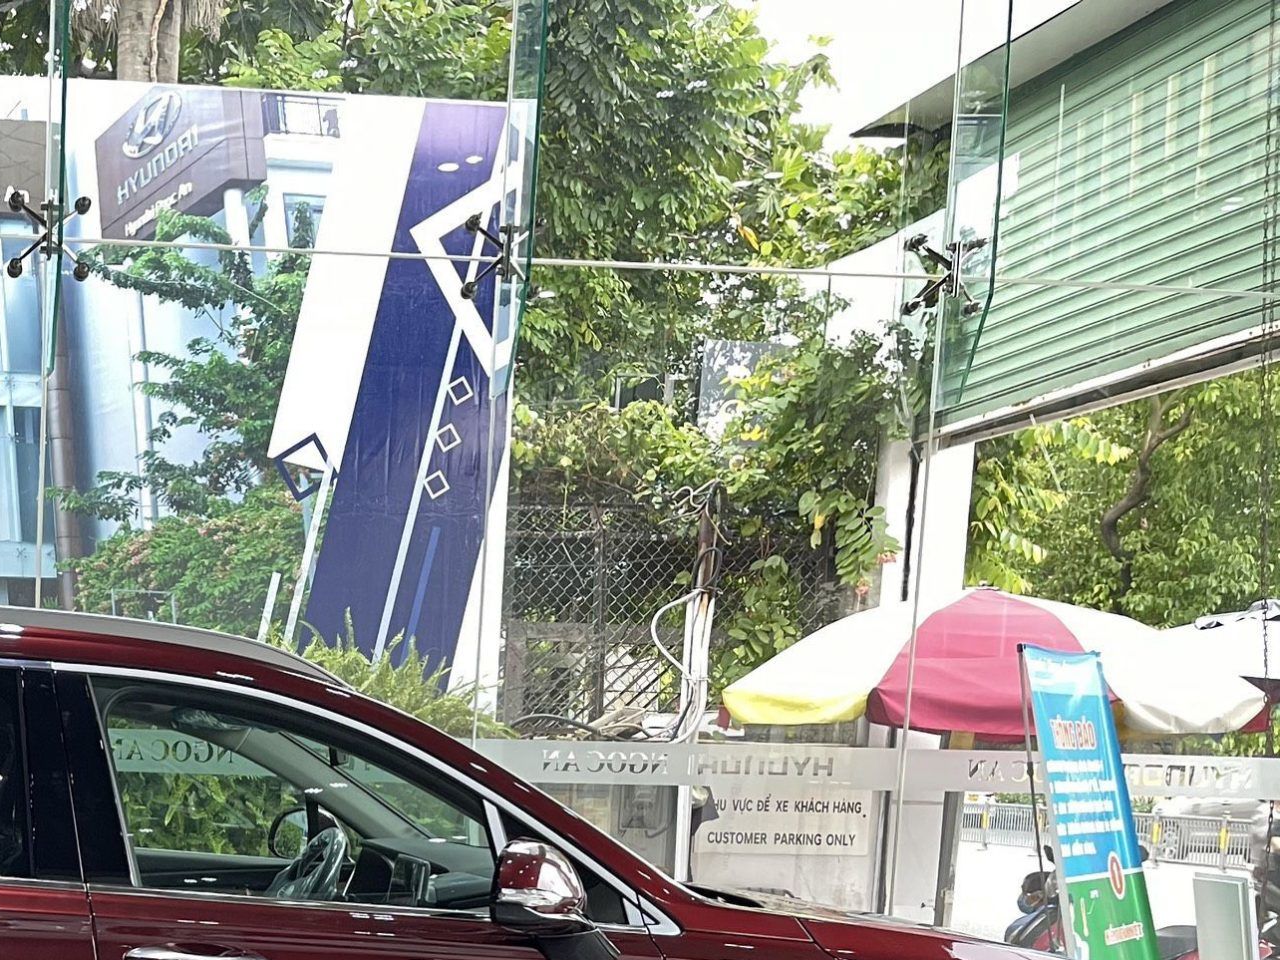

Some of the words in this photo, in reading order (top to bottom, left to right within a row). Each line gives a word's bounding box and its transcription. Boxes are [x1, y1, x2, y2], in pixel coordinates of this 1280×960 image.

[116, 124, 199, 206] HYUNDAI
[775, 799, 789, 812] XE
[794, 797, 830, 813] KHÁCH
[707, 831, 767, 845] CUSTOMER
[774, 832, 822, 846] PARKING
[825, 833, 856, 846] ONLY
